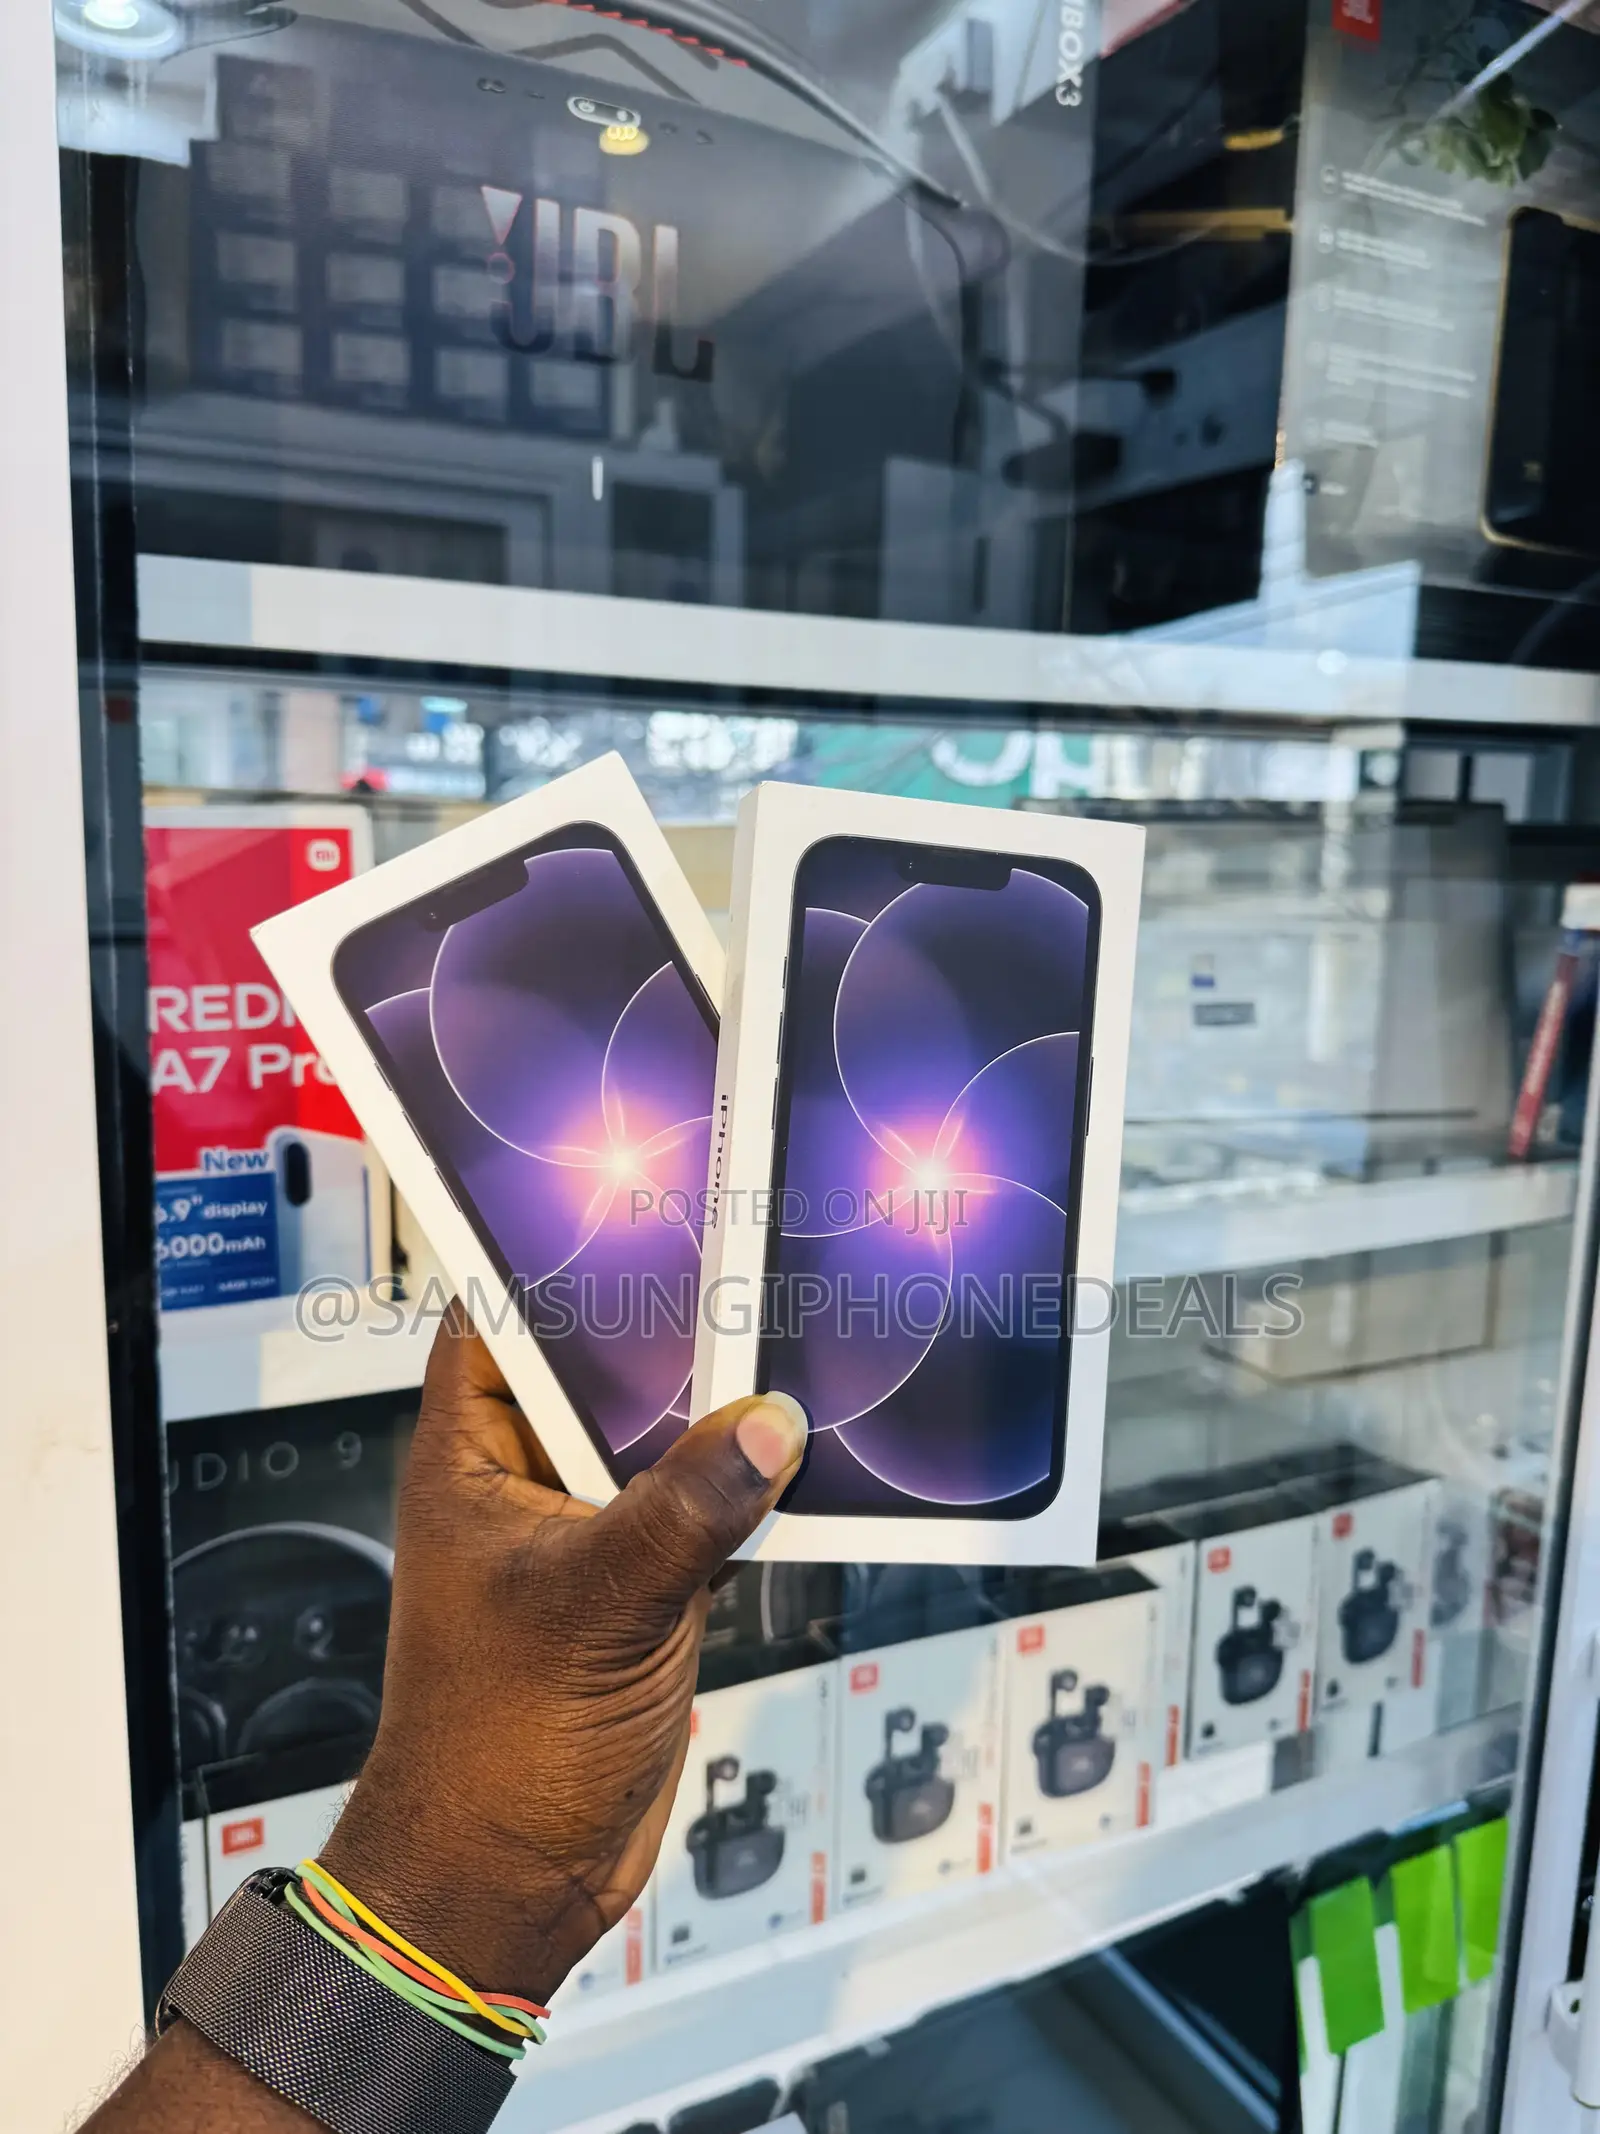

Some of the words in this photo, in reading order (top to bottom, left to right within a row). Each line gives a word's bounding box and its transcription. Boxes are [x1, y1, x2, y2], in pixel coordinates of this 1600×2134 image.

[489, 198, 715, 383] JBL
[147, 983, 297, 1032] RED
[150, 1047, 231, 1095] A7
[202, 1150, 269, 1171] New
[711, 1094, 729, 1229] iPhone
[203, 1201, 268, 1219] display
[336, 1431, 363, 1470] 9
